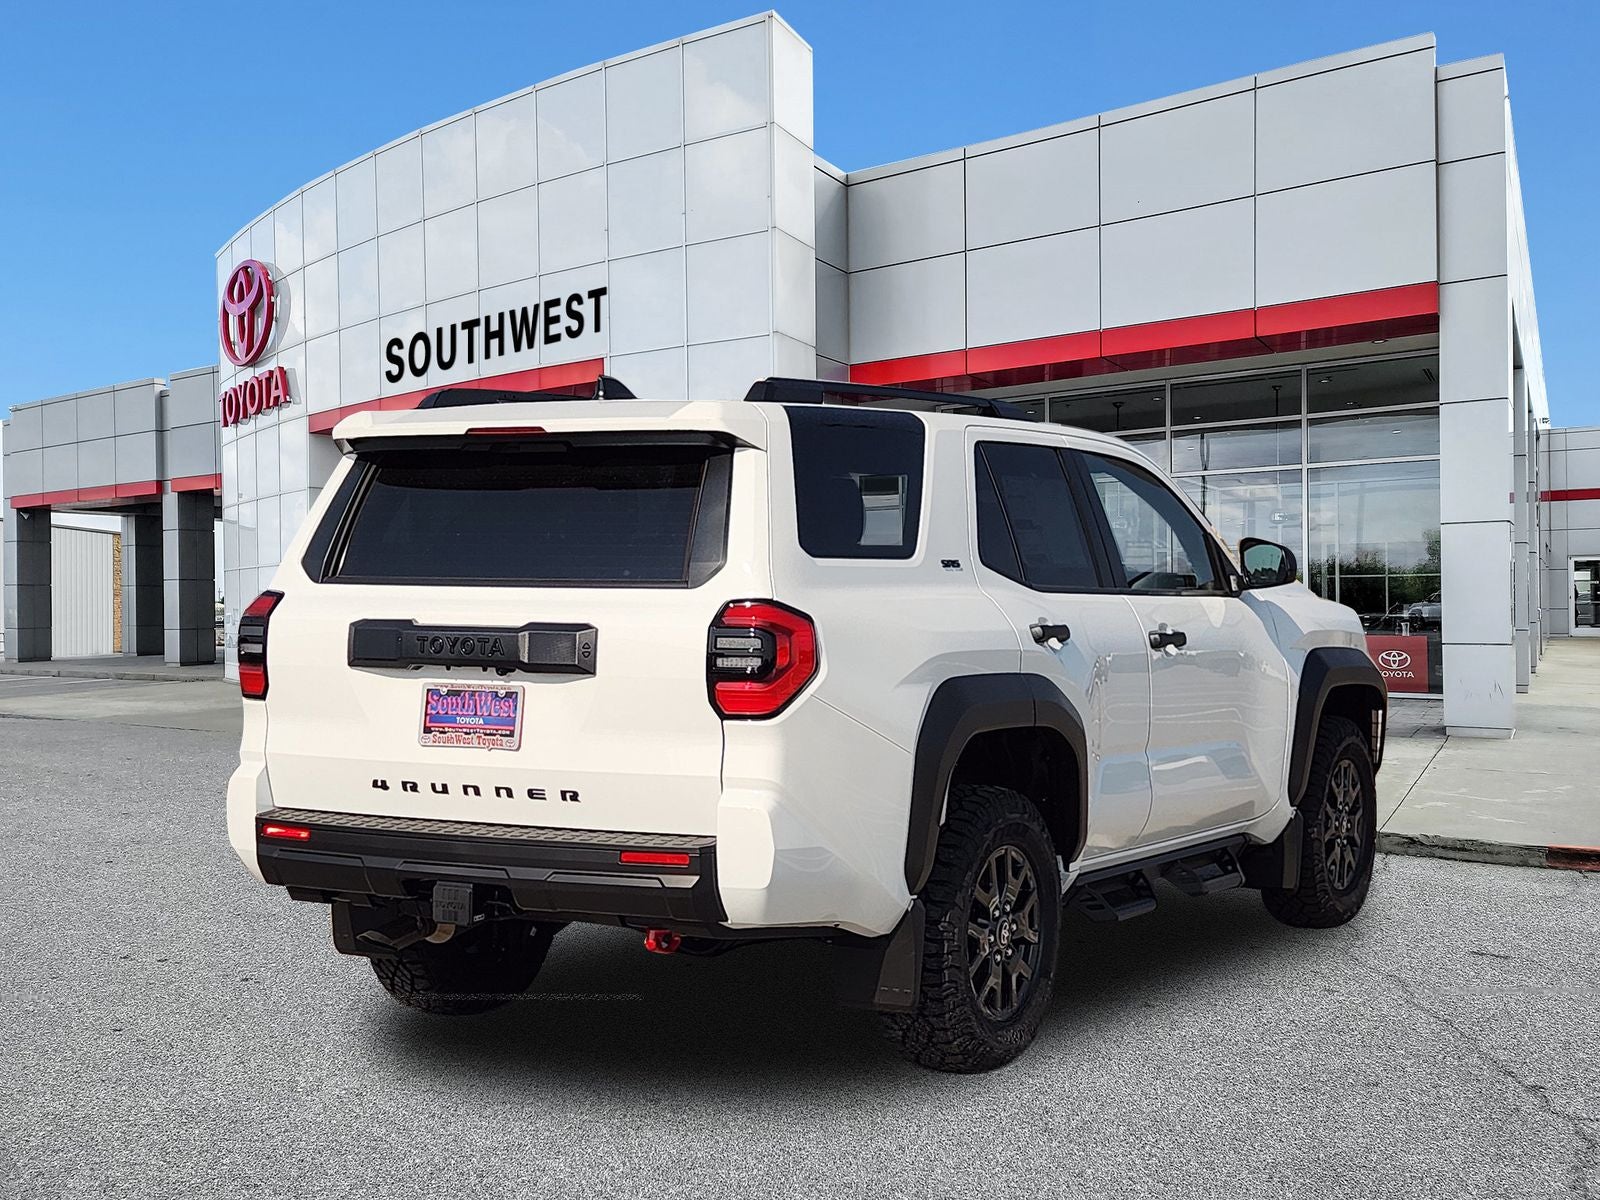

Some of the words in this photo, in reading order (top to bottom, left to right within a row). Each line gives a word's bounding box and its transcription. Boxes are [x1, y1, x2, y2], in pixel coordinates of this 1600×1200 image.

[385, 286, 608, 384] SOUTHWEST
[219, 366, 292, 428] TOYOTA
[416, 635, 505, 657] TOYOTA
[456, 716, 484, 725] TOYOTA
[476, 735, 504, 748] Toyota
[372, 779, 581, 802] 4RUNNER
